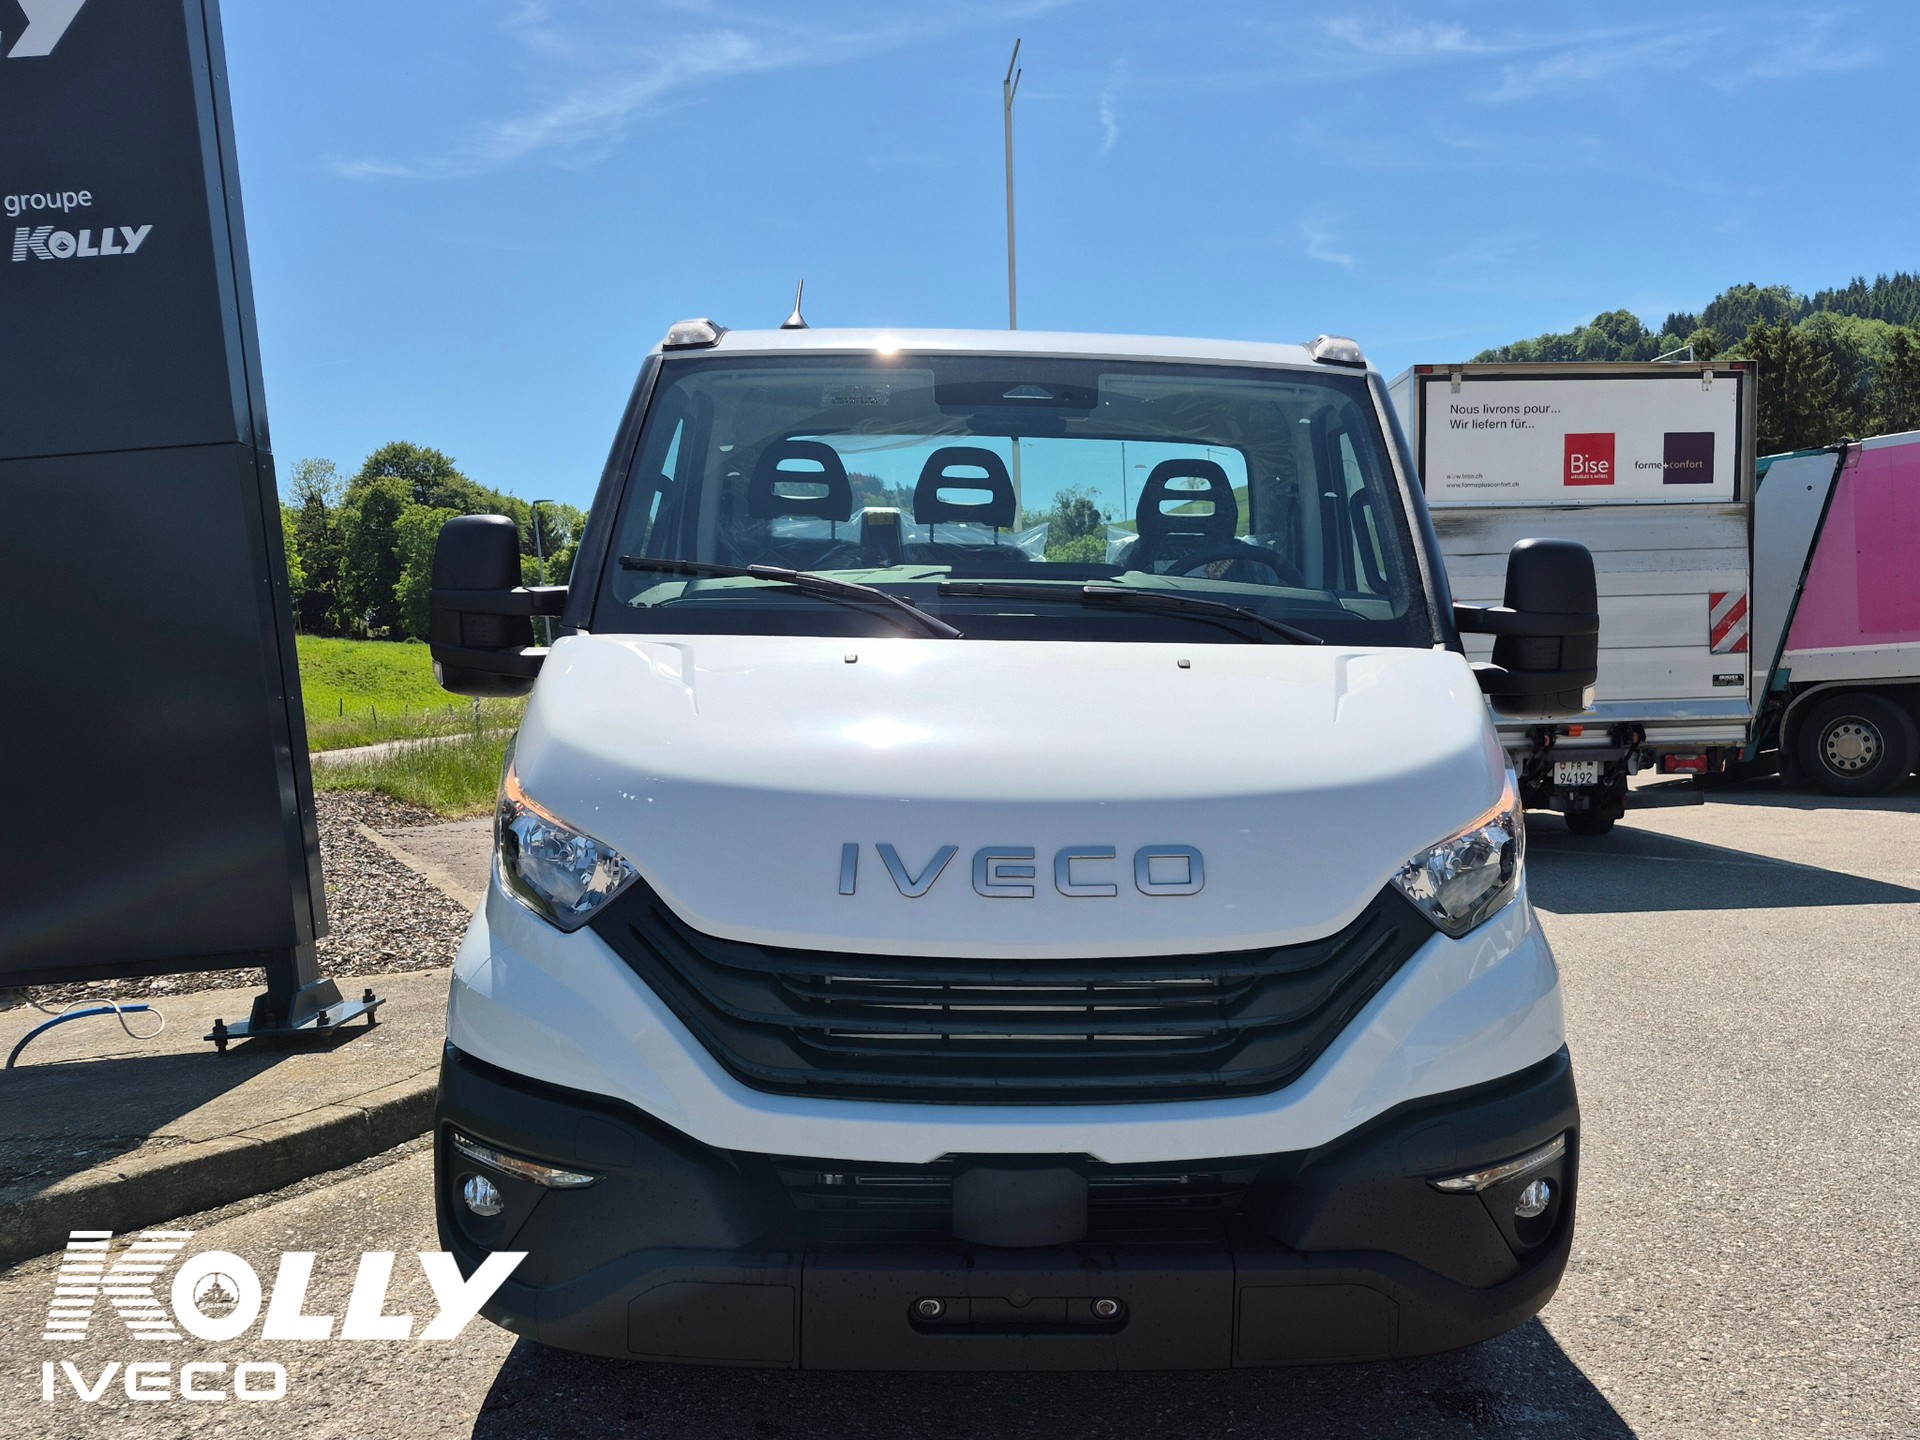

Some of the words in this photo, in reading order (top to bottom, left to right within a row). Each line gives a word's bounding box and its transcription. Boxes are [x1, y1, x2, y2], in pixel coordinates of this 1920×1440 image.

[4, 189, 93, 217] groupe
[12, 224, 153, 262] KOLLY
[1450, 404, 1480, 415] Nous
[1483, 404, 1521, 414] livrons
[1450, 419, 1469, 429] Wir
[1472, 419, 1507, 429] liefern
[1570, 453, 1609, 474] Bise
[1570, 761, 1582, 771] FR
[1560, 772, 1593, 784] 94192
[839, 842, 1206, 899] IVECO
